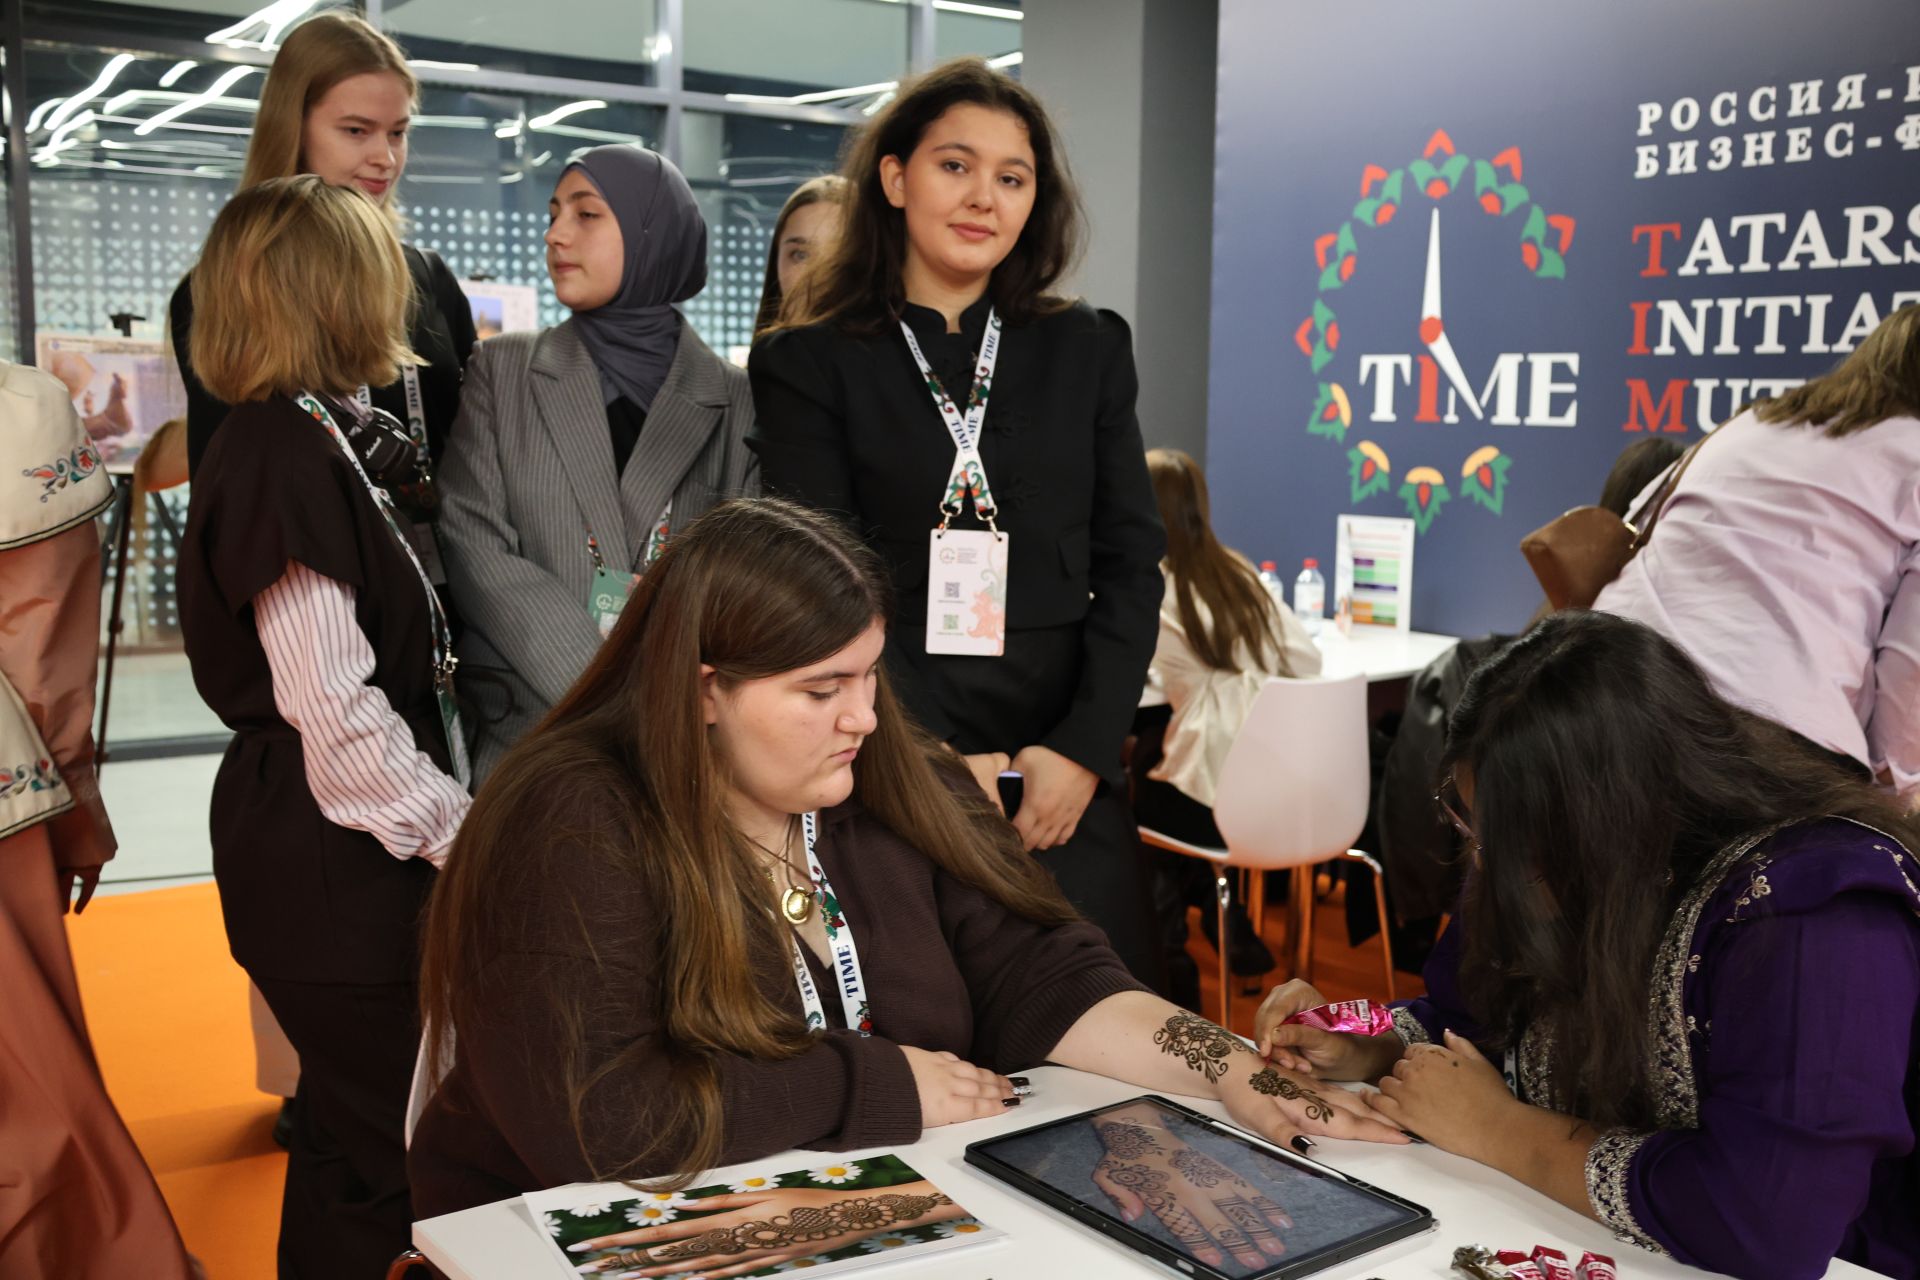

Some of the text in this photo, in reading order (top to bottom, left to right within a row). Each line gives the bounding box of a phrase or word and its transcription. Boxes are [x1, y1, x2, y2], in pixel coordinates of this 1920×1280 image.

[984, 331, 997, 361] TIME
[1626, 291, 1920, 356] INITIA
[1359, 352, 1580, 427] TIME
[951, 419, 972, 453] TIME
[837, 944, 859, 998] TIME
